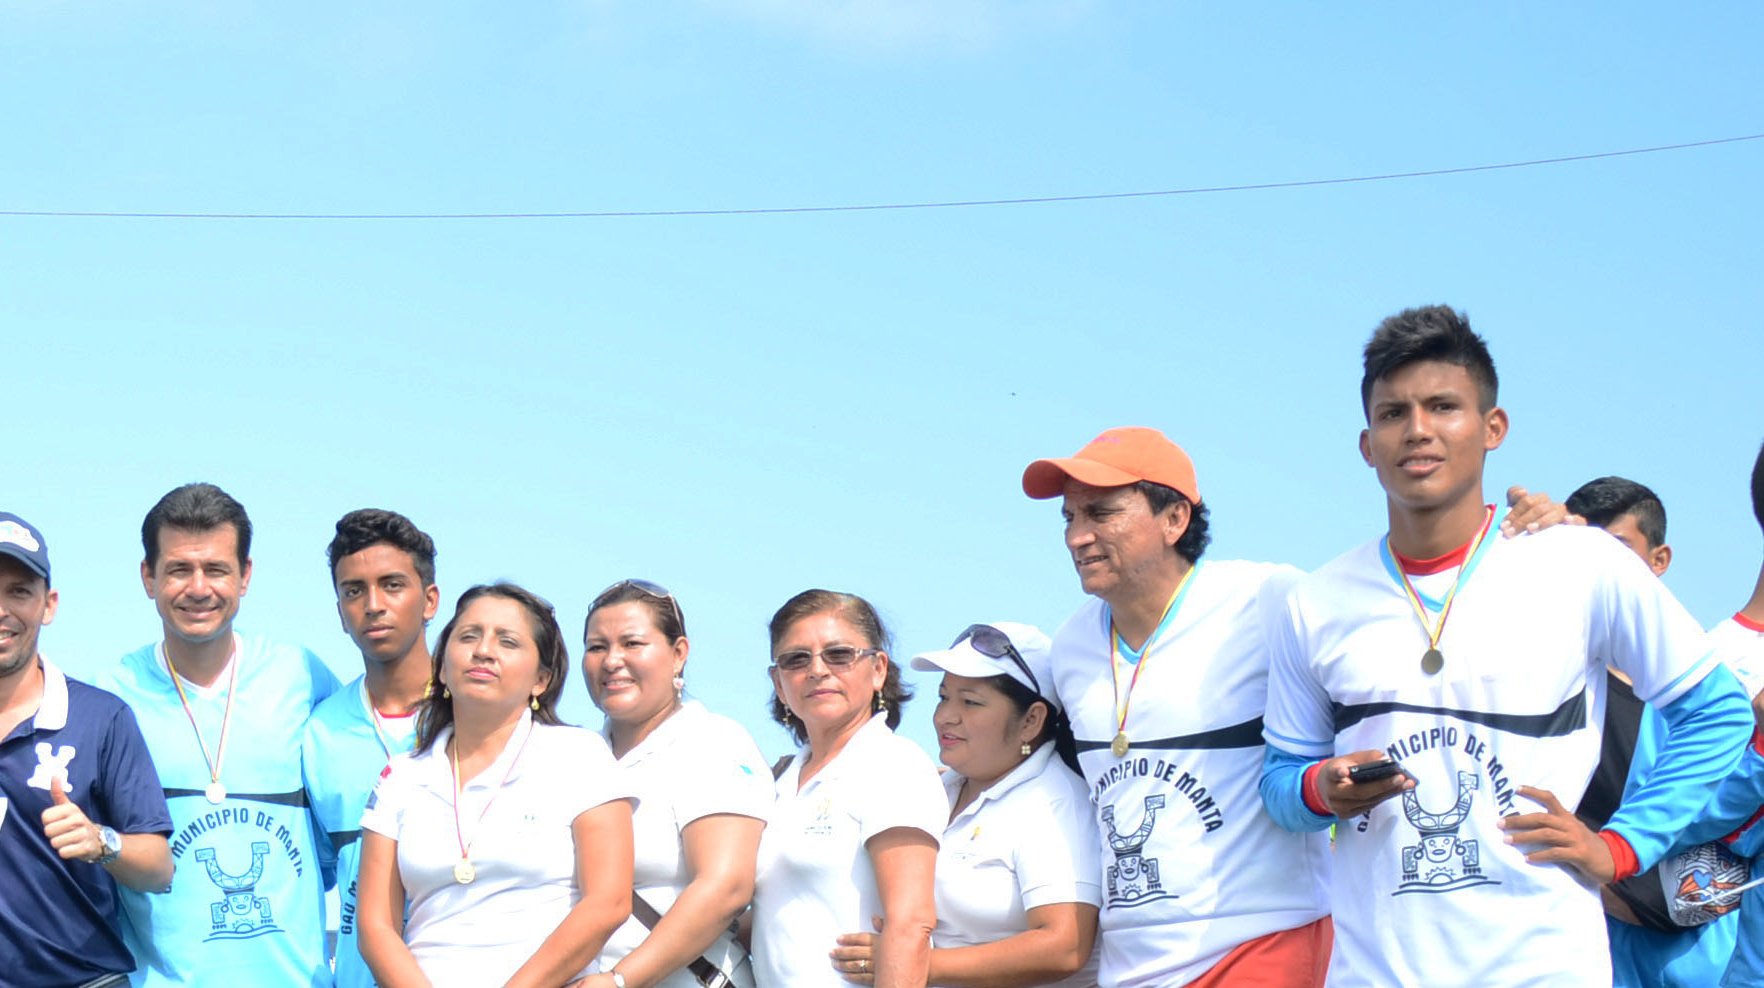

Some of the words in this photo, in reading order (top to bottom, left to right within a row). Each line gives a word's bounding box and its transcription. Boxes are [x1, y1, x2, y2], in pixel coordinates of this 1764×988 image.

[1153, 759, 1177, 782] DE
[1174, 771, 1223, 833] MANTA
[1386, 726, 1457, 761] NICIPIO
[1464, 734, 1486, 762] DE
[1487, 755, 1521, 818] MANT
[171, 808, 249, 859] MUNICIPIO
[255, 811, 274, 832] DE
[275, 825, 303, 878] MANTA
